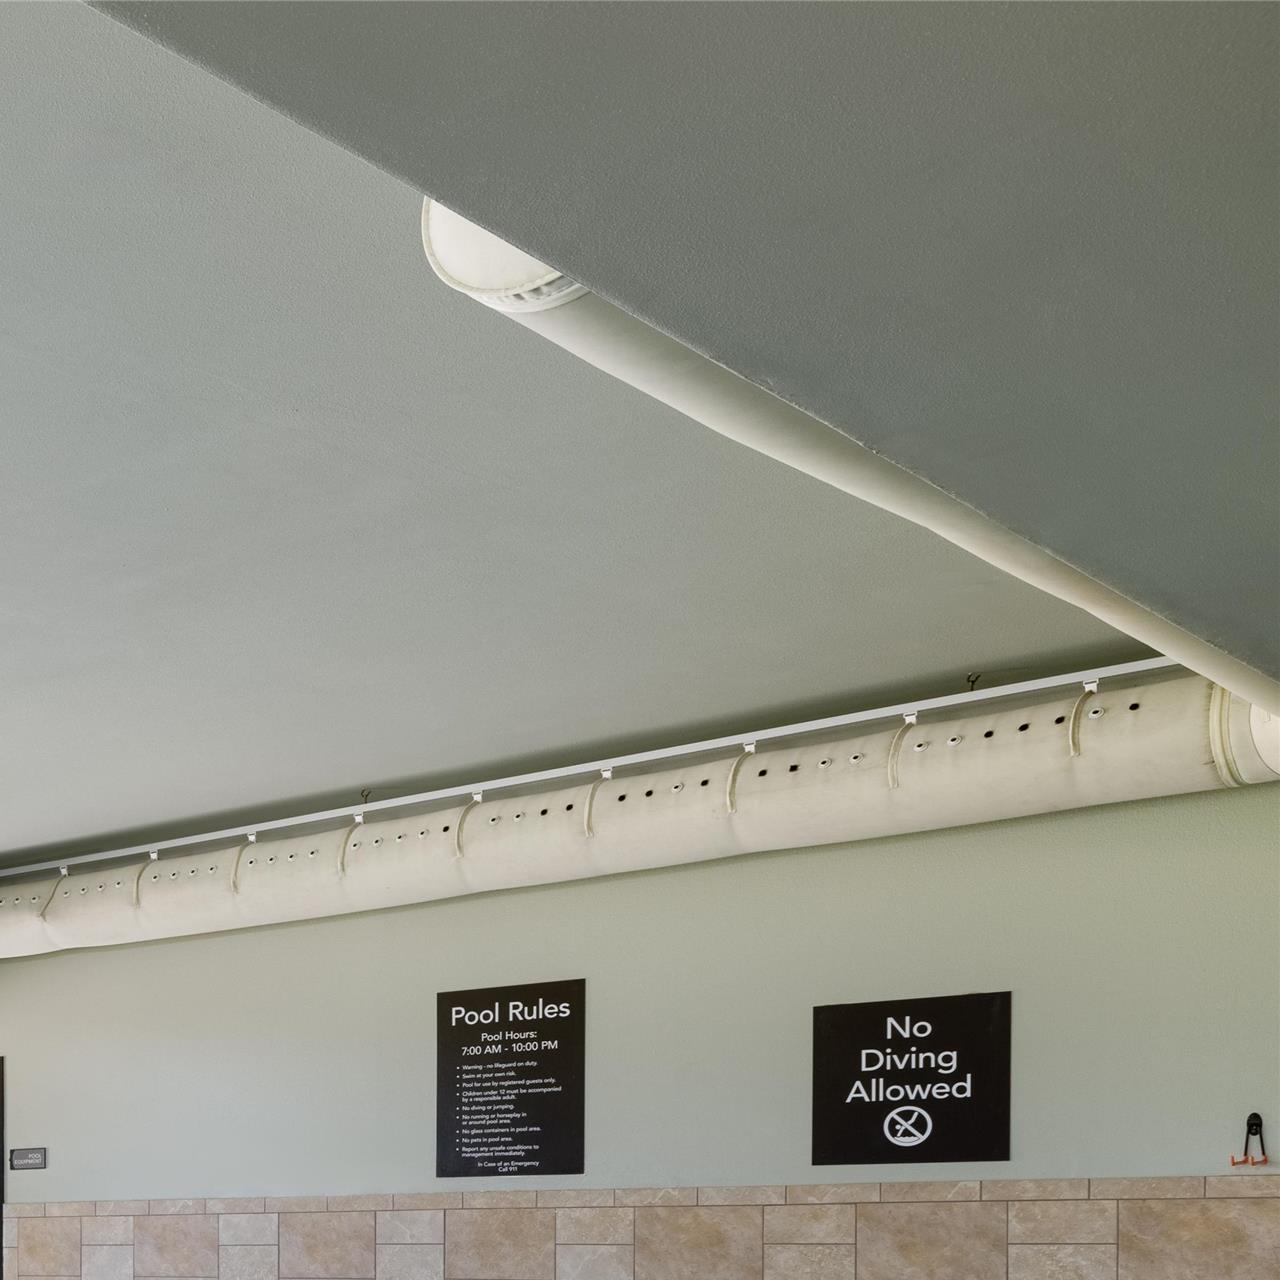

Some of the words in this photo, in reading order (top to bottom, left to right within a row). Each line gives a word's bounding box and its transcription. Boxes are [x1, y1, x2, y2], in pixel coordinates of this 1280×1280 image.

[451, 1002, 499, 1026] Pool
[508, 998, 570, 1021] Rules
[481, 1032, 502, 1041] Pool
[505, 1030, 537, 1040] Hours:
[886, 1016, 932, 1039] No
[462, 1046, 482, 1056] 7:00
[484, 1044, 502, 1054] AM
[512, 1042, 538, 1052] 10:00
[541, 1040, 558, 1050] PM
[860, 1046, 958, 1074] Diving
[845, 1073, 972, 1103] Allowed
